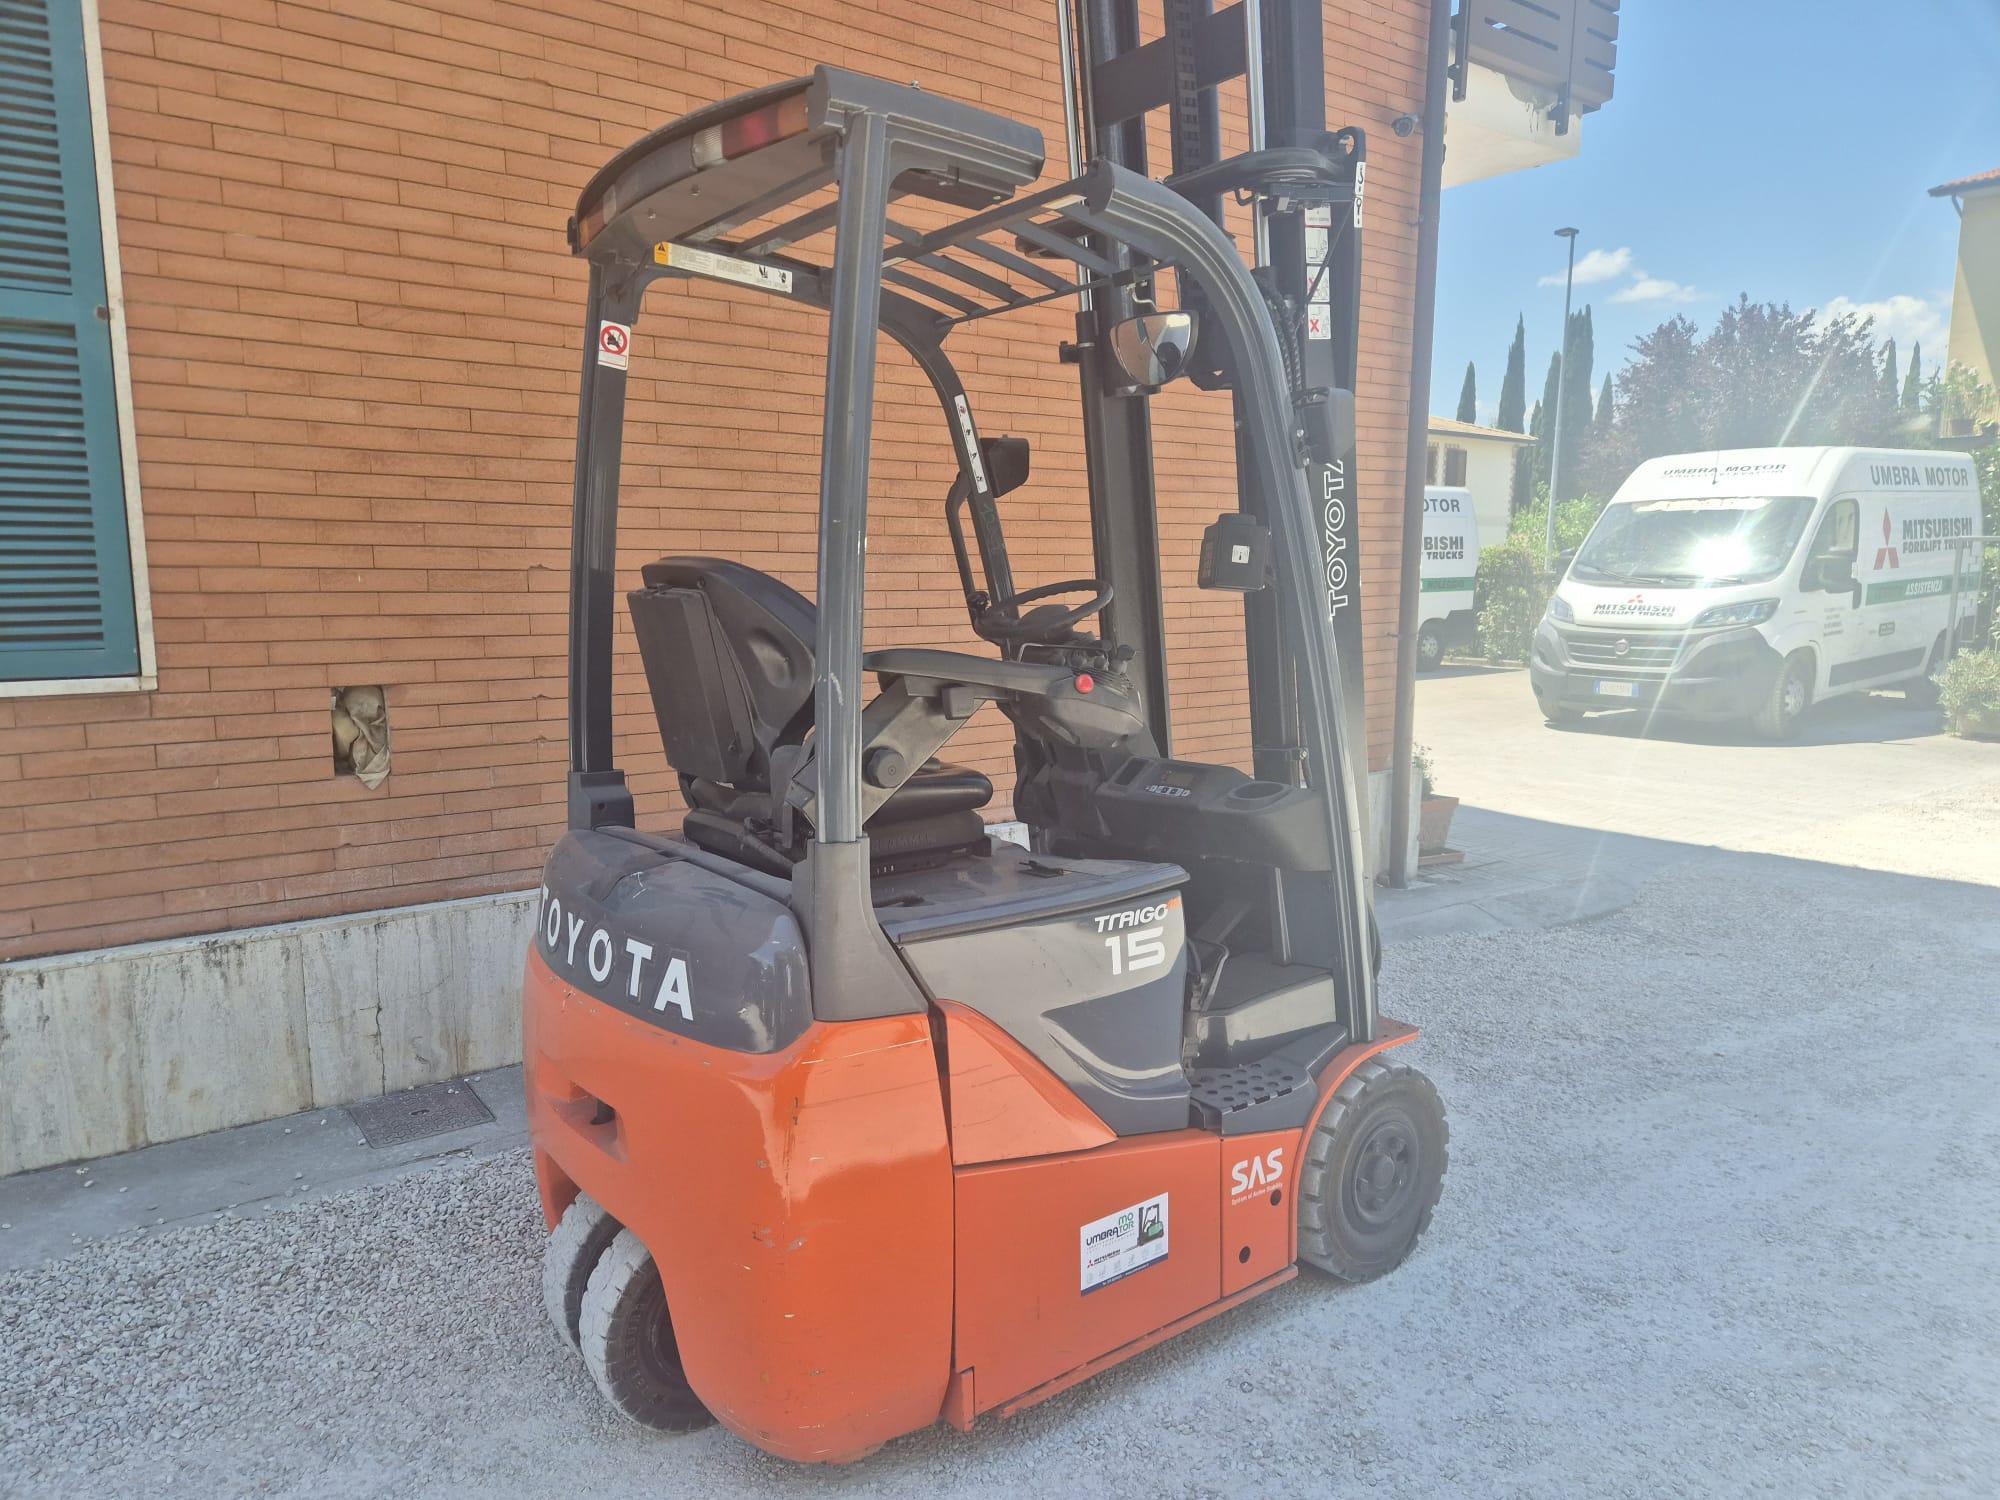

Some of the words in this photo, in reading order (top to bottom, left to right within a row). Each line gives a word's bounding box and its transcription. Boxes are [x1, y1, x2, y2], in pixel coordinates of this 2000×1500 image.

[1664, 467, 1718, 476] UMBRA
[1725, 464, 1787, 473] MOTOR
[1870, 465, 1920, 486] UMBRA
[1925, 467, 1969, 486] MOTOR
[1903, 517, 1972, 540] MITSUBISHI
[1424, 536, 1464, 550] BISHI
[1903, 539, 1942, 554] FORKLIFT
[1426, 551, 1464, 560] TRUCKS
[1905, 579, 1943, 595] ASSISTENZA
[1595, 604, 1676, 613] MITSUBISHI
[1094, 903, 1169, 933] TRAIGO
[1105, 926, 1165, 975] 15
[1231, 1147, 1283, 1196] SAS
